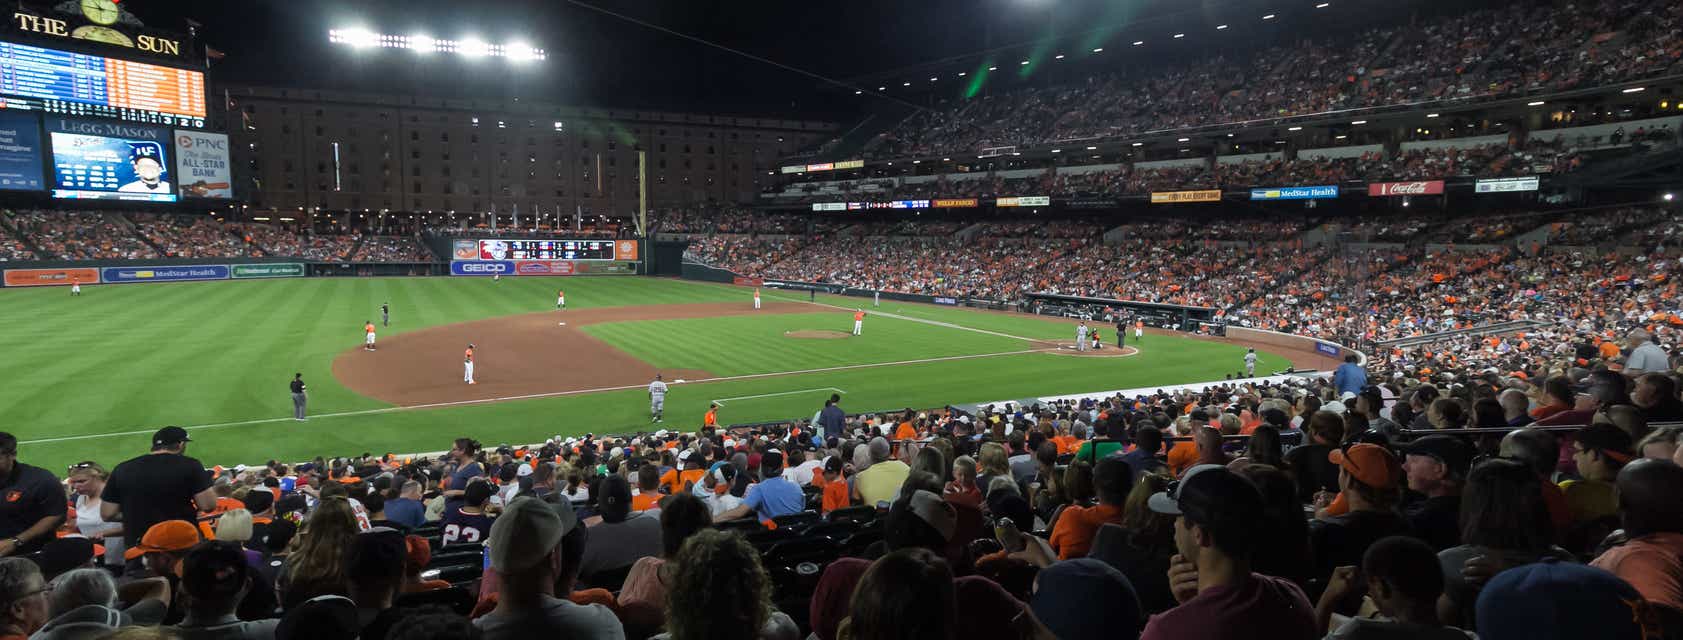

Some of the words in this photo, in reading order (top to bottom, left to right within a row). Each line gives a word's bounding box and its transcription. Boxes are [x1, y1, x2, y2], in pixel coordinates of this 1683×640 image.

[15, 12, 68, 37] THE
[137, 35, 179, 55] SUN
[164, 116, 172, 124] 3
[181, 119, 189, 127] 2
[106, 124, 156, 139] MASON
[195, 137, 225, 150] PNC
[183, 158, 225, 169] ALL-STAR
[192, 168, 216, 177] BANK
[1311, 188, 1336, 196] Health
[462, 264, 506, 272] GEICO
